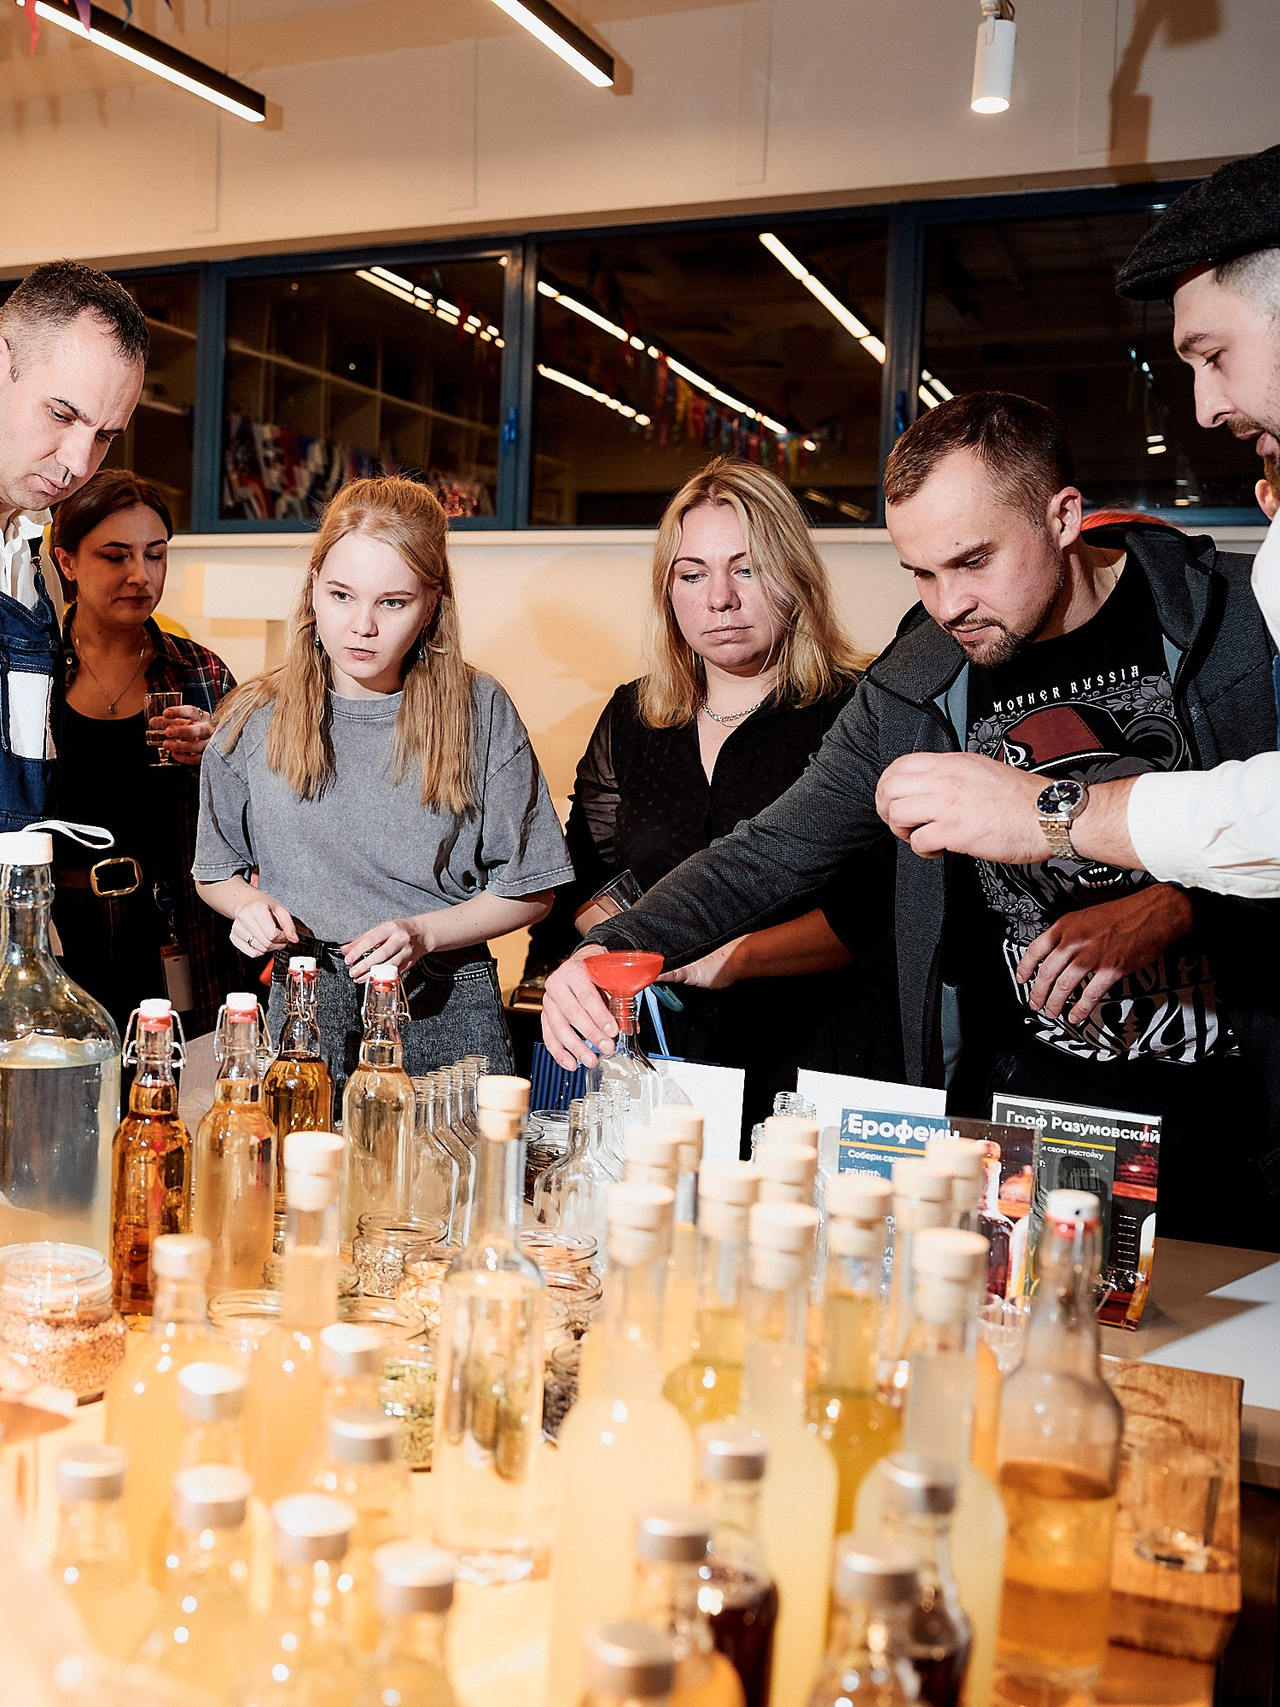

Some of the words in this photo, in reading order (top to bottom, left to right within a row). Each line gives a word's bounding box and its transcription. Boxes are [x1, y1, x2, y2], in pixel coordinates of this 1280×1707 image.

[993, 686, 1061, 713] MOTHER
[1070, 665, 1140, 695] RUSSIA
[1051, 1116, 1161, 1144] Разумовский
[847, 1149, 883, 1162] Собери
[883, 1155, 906, 1163] сво
[1047, 1146, 1068, 1155] свою
[1068, 1149, 1105, 1161] настойку
